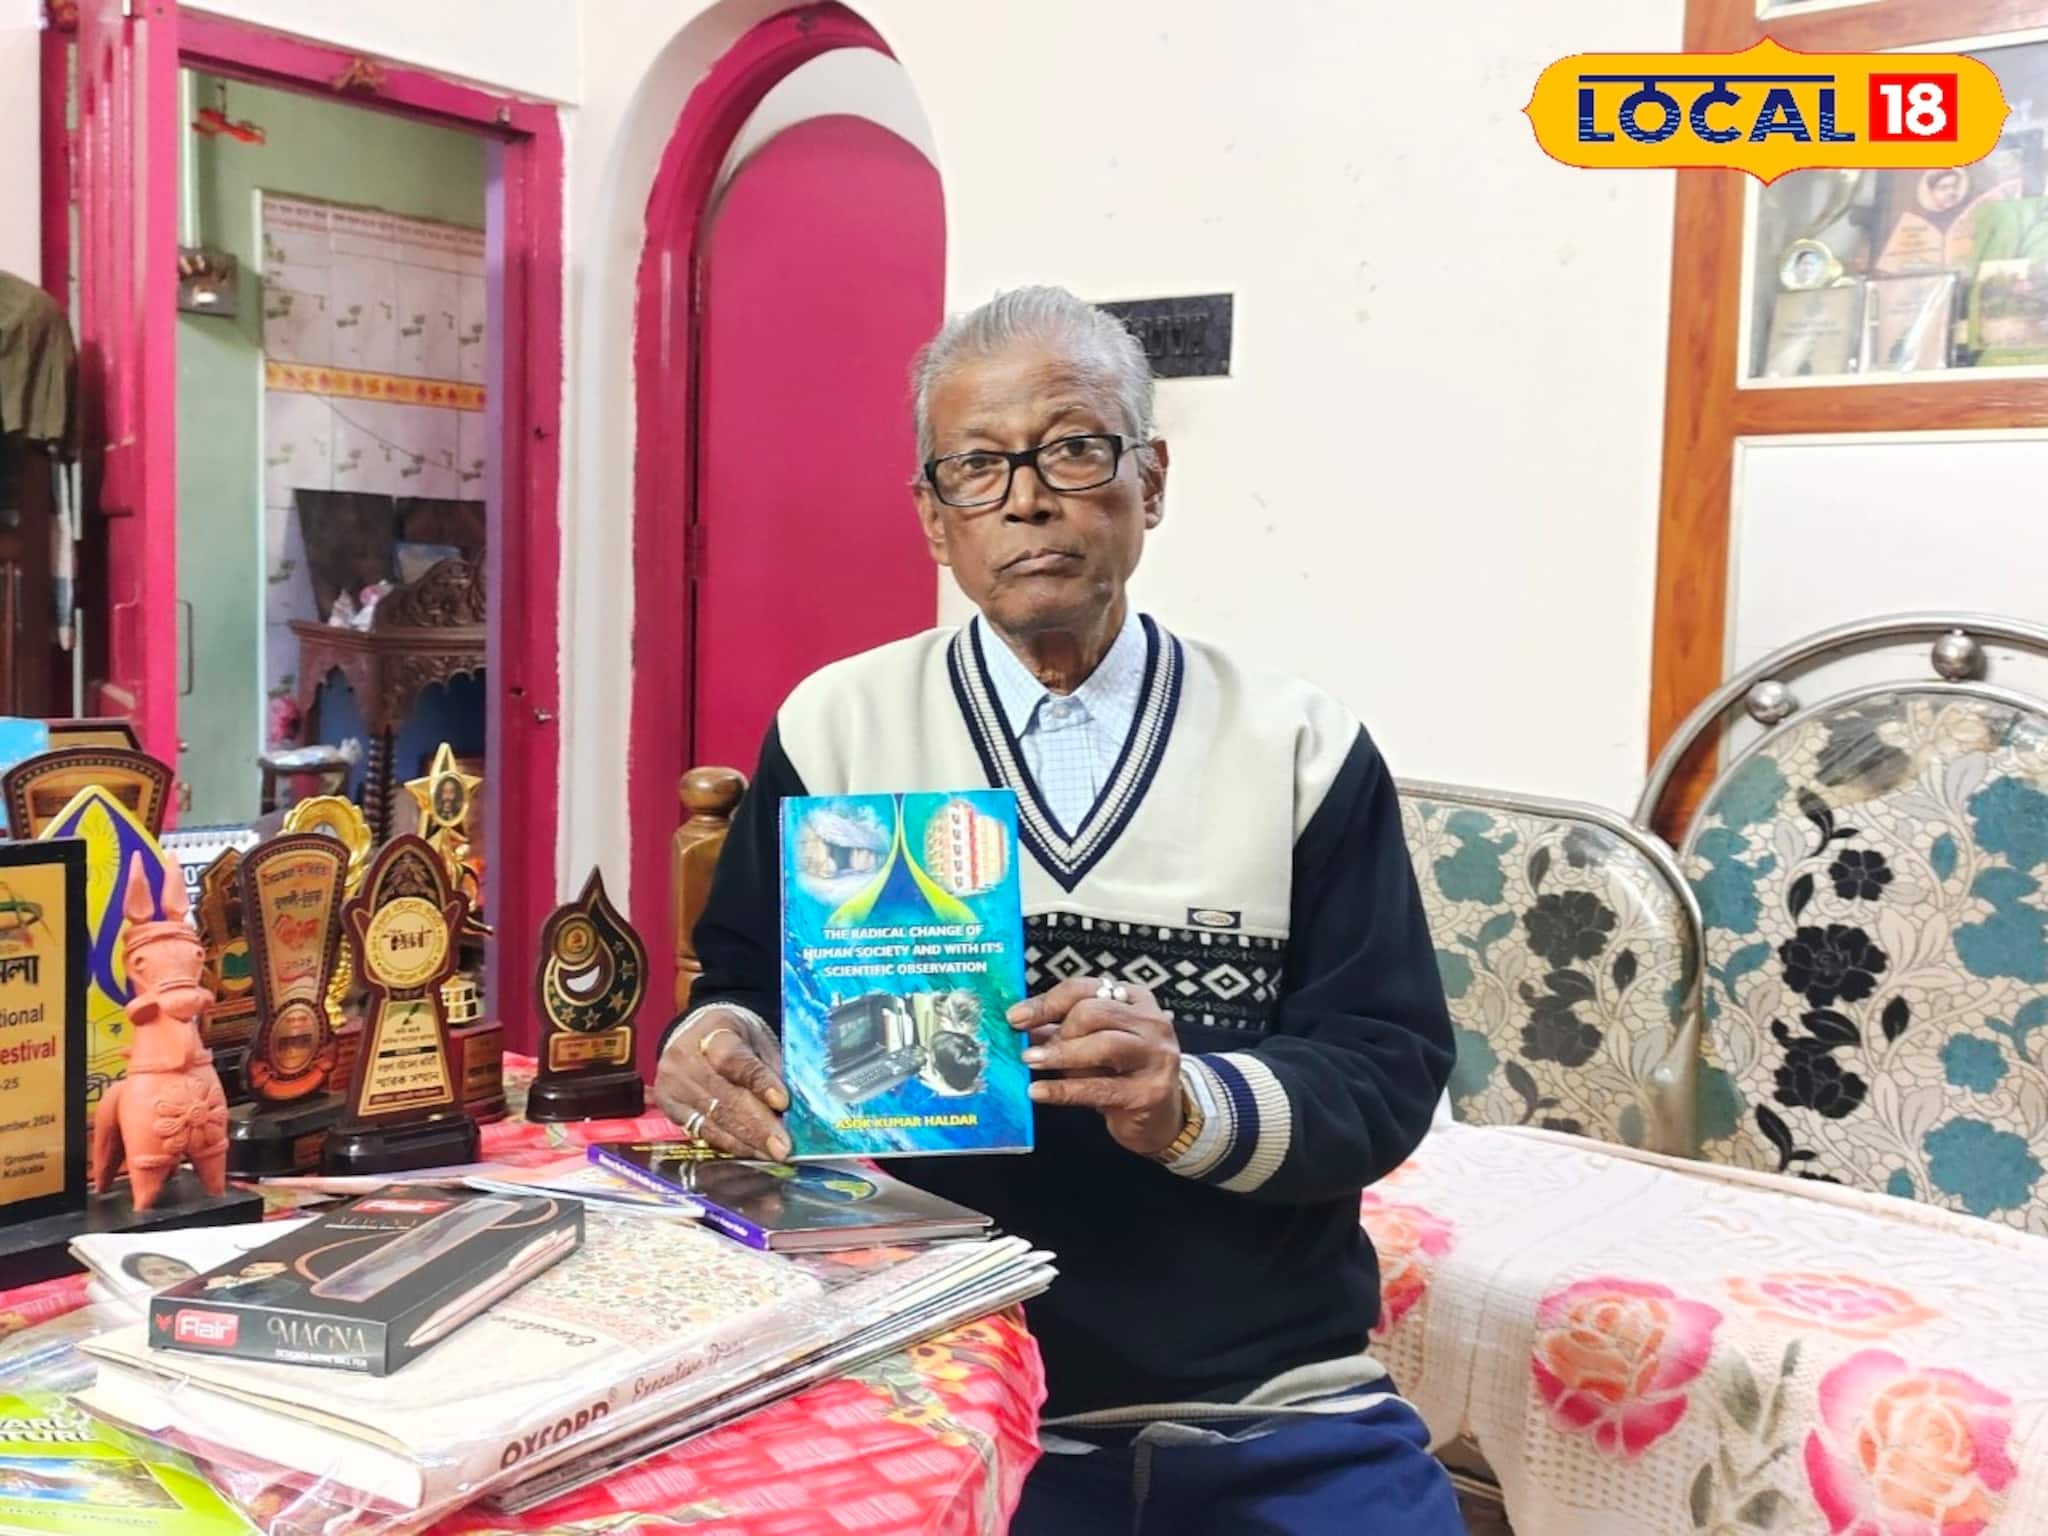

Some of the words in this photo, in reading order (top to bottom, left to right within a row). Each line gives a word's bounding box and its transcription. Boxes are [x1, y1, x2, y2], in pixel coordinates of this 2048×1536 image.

[823, 928, 849, 940] THE
[851, 926, 905, 940] RADICAL
[909, 924, 963, 938] CHANGE
[965, 924, 984, 937] OF
[803, 947, 854, 960] HUMAN
[856, 944, 910, 958] SOCIETY
[913, 943, 941, 956] AND
[943, 942, 979, 955] WITH
[823, 963, 895, 977] SCIENTIFIC
[897, 961, 988, 975] OBSERVATION
[874, 1116, 921, 1128] KUMAR
[924, 1114, 978, 1127] HALDAR
[180, 1315, 232, 1339] Flair
[266, 1316, 367, 1353] MAGNA
[499, 1401, 610, 1470] OXFORD
